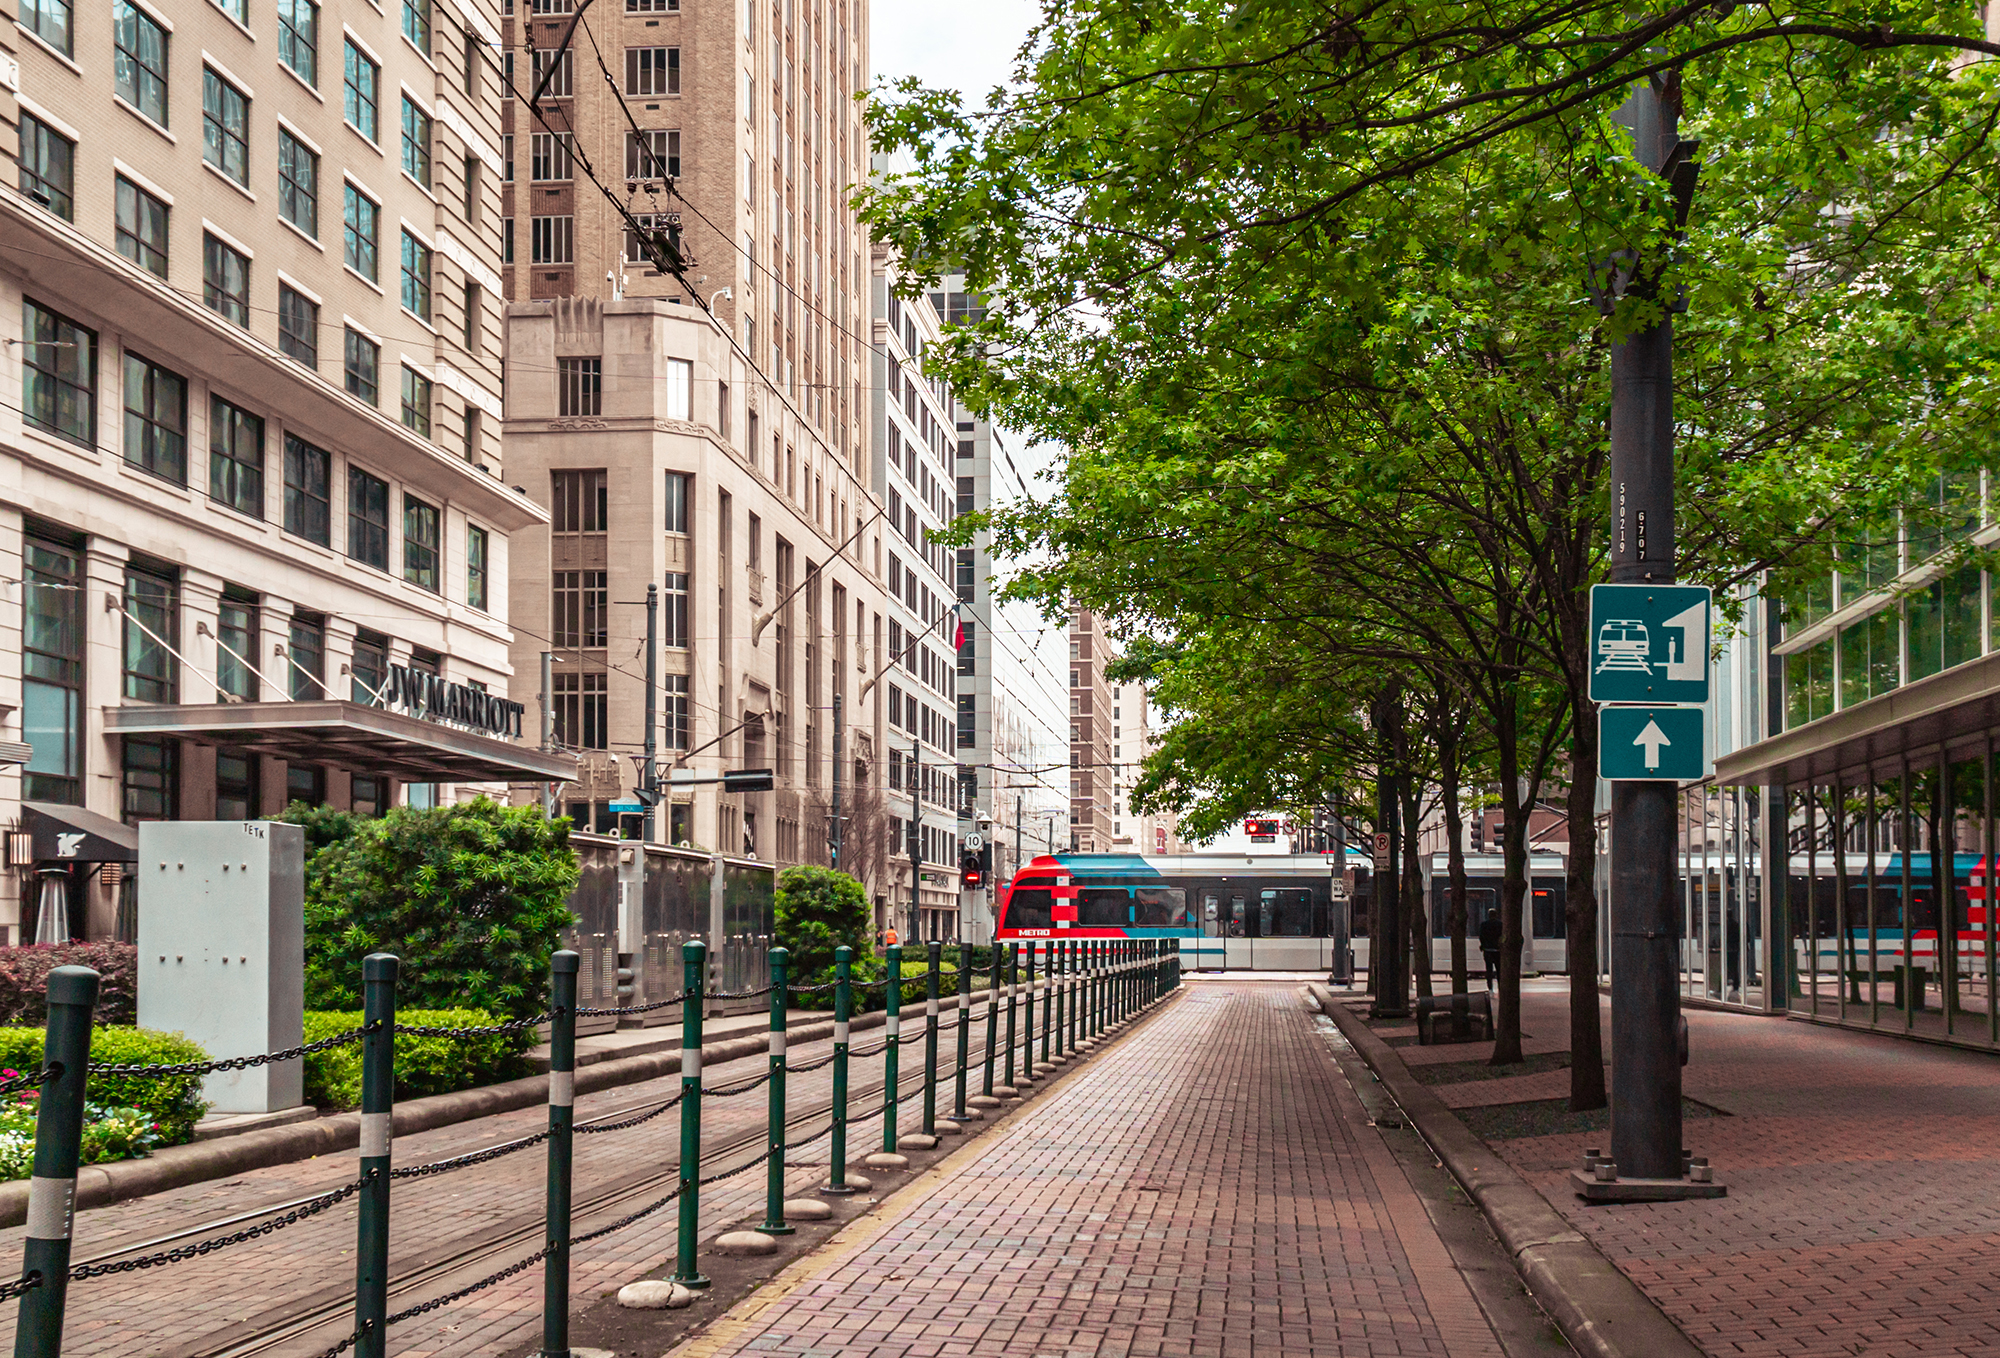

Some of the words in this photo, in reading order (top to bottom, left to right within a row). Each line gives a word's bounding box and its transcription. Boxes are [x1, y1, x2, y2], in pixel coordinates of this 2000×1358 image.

[386, 663, 424, 710] JW
[425, 674, 525, 739] MARRIOTT
[968, 836, 980, 846] 10
